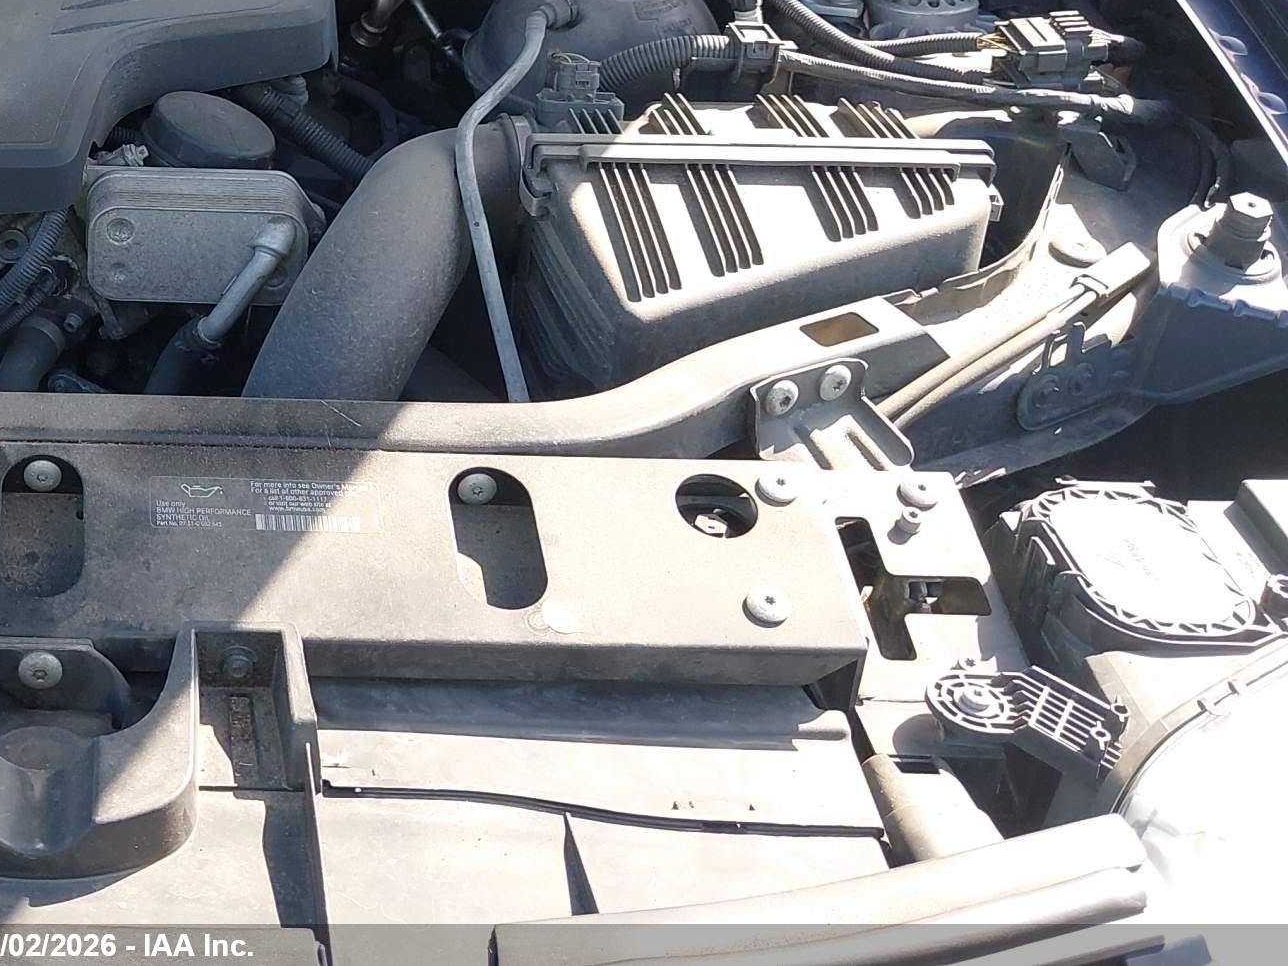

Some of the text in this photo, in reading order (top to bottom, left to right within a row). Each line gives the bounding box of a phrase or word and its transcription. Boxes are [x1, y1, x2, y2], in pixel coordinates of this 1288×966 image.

[156, 499, 186, 508] Use only
[156, 506, 176, 514] BMW
[196, 507, 252, 516] PERFORMANCE
